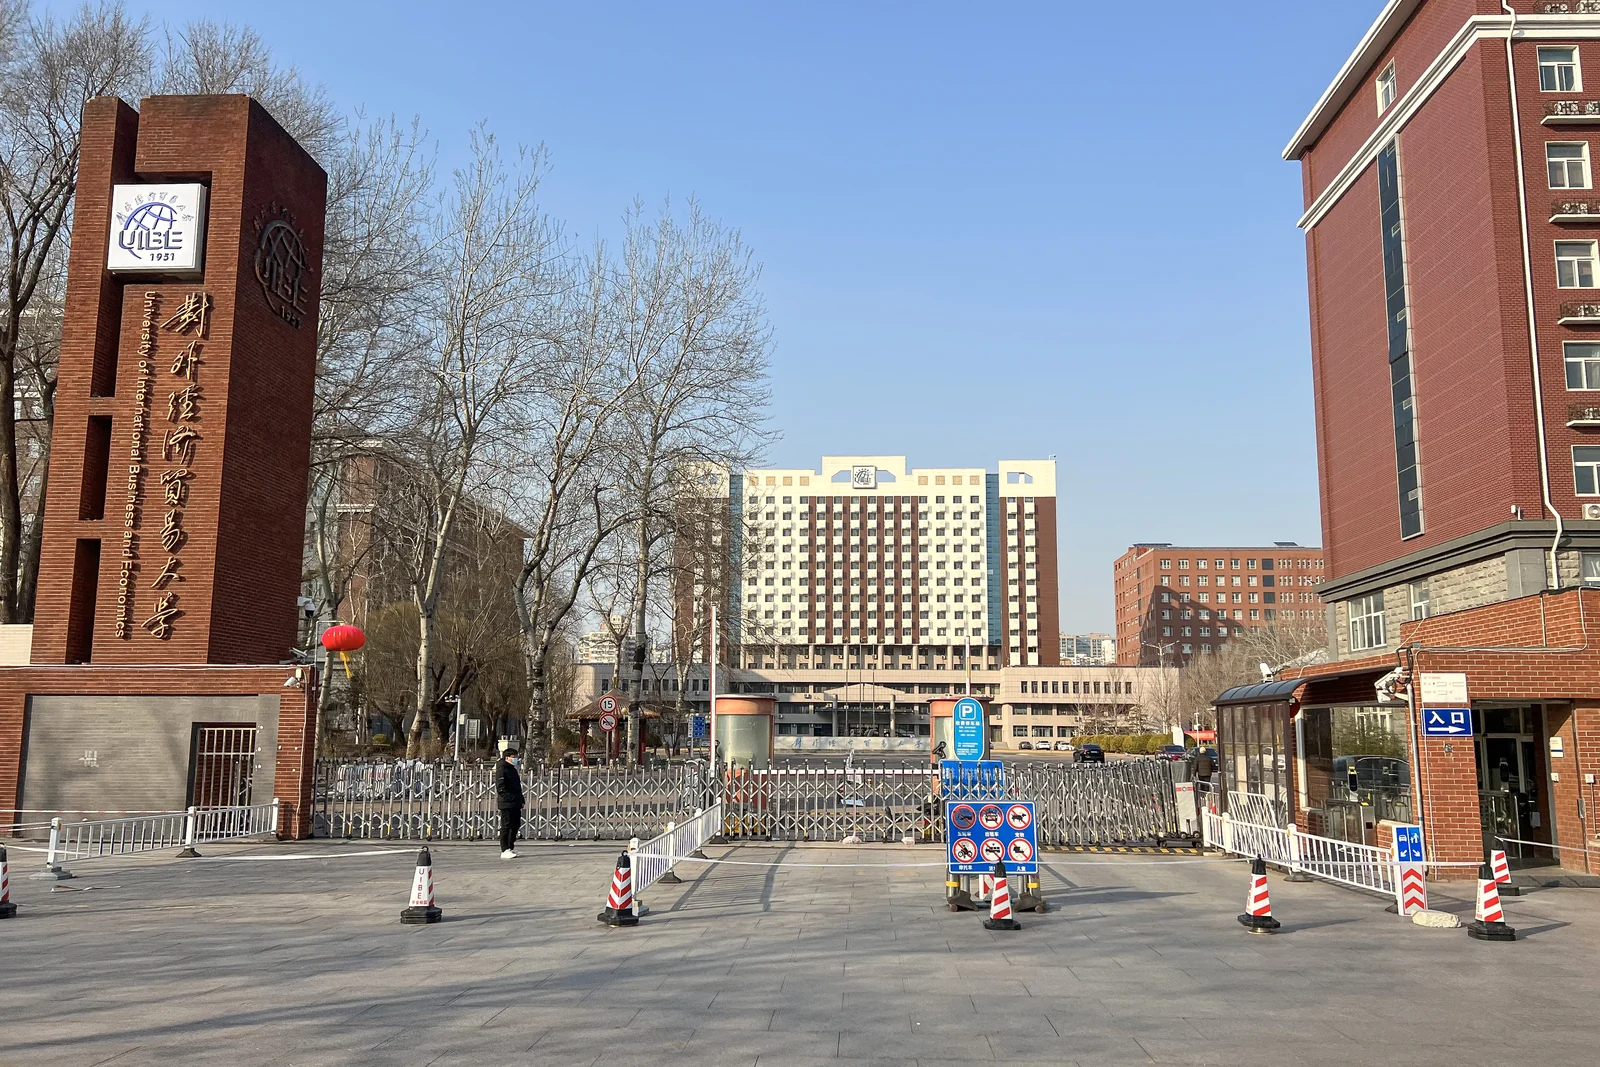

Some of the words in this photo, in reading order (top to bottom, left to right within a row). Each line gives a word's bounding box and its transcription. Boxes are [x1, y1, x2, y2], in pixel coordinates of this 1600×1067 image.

[150, 253, 175, 261] 1951
[137, 291, 156, 357] University
[136, 360, 149, 374] of
[130, 375, 149, 461] International
[125, 465, 140, 527] Business
[122, 531, 133, 557] and
[115, 560, 132, 638] Economics
[603, 701, 613, 709] 15
[962, 705, 973, 718] P
[1428, 711, 1465, 725] 入口
